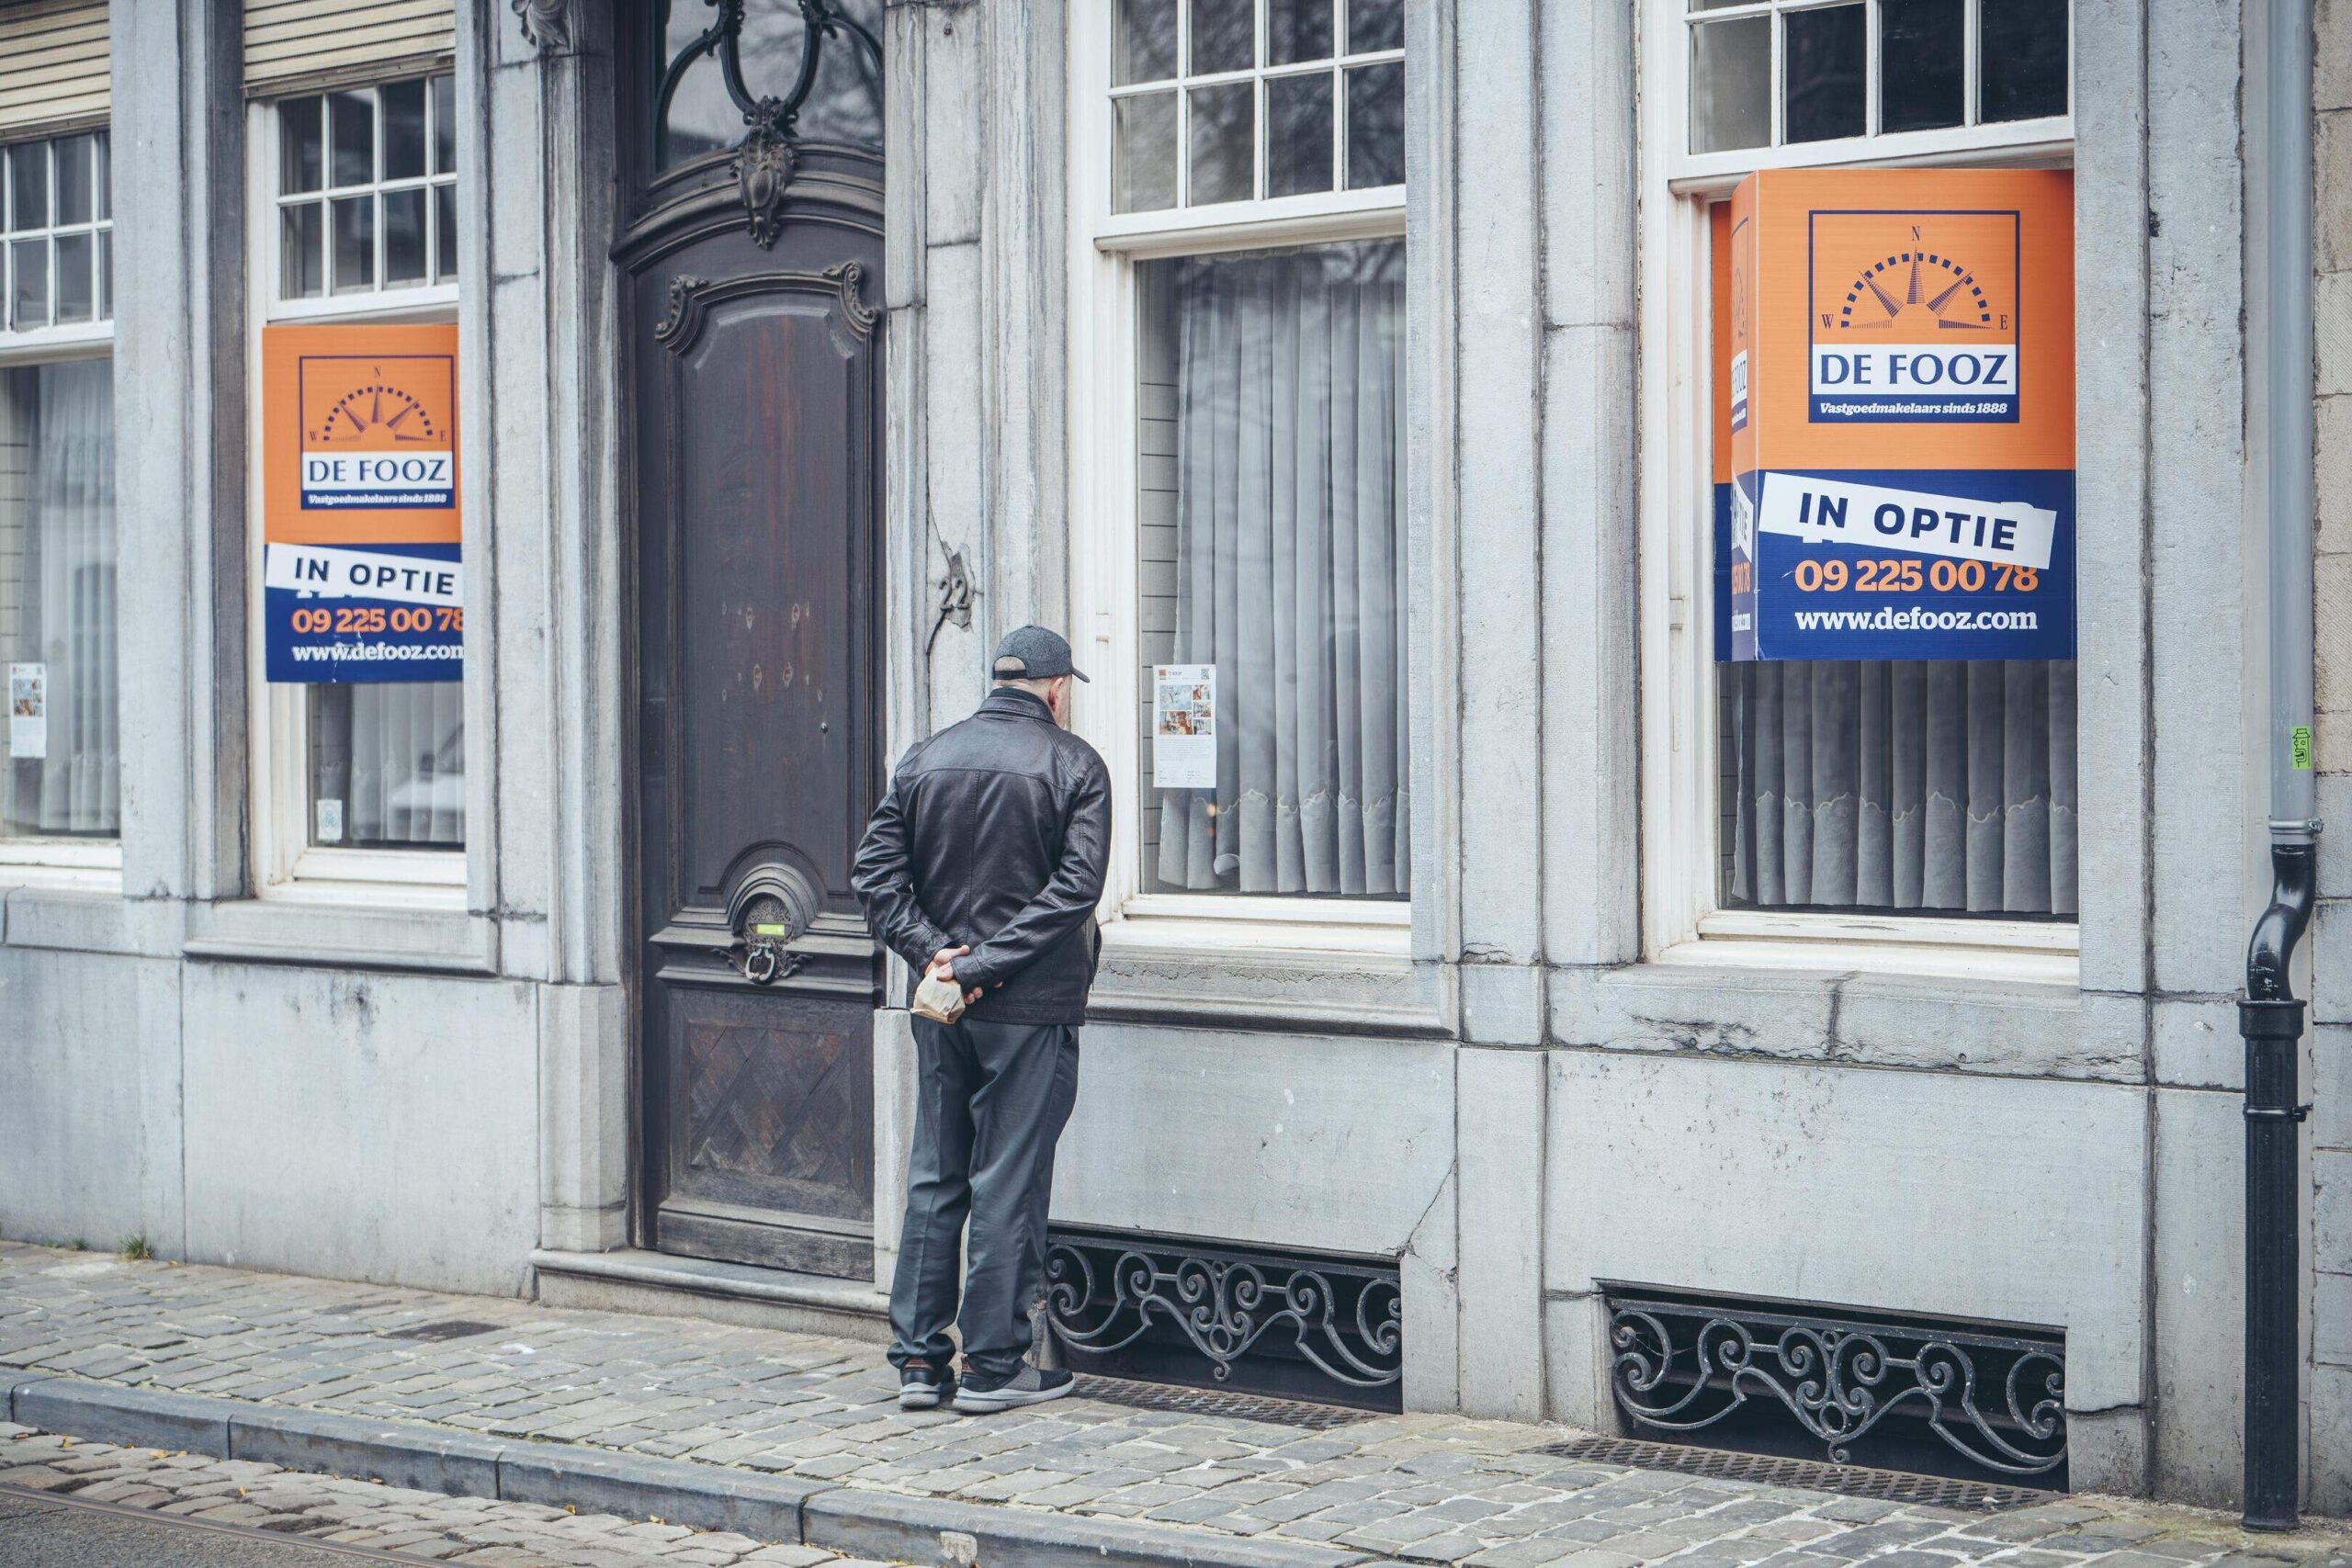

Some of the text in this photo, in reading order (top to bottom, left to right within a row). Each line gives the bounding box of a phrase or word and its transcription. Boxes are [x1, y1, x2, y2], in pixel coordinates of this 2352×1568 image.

[1911, 226, 1921, 242] N
[1821, 313, 1835, 330] W
[1999, 314, 2008, 330] E
[1820, 354, 2008, 385] DE FOOZ
[1819, 402, 2008, 416] Vastgoedmakelaars sinds 1888
[309, 458, 447, 482] DE FOOZ
[1798, 491, 2018, 552] IN OPTIE
[294, 557, 456, 596] IN OPTIE
[1794, 558, 2039, 592] 09 225 00 78
[939, 575, 971, 612] 22
[291, 607, 332, 634] 09
[335, 607, 387, 634] 225
[390, 607, 433, 634] 00
[1794, 606, 2038, 630] www.defooz.com
